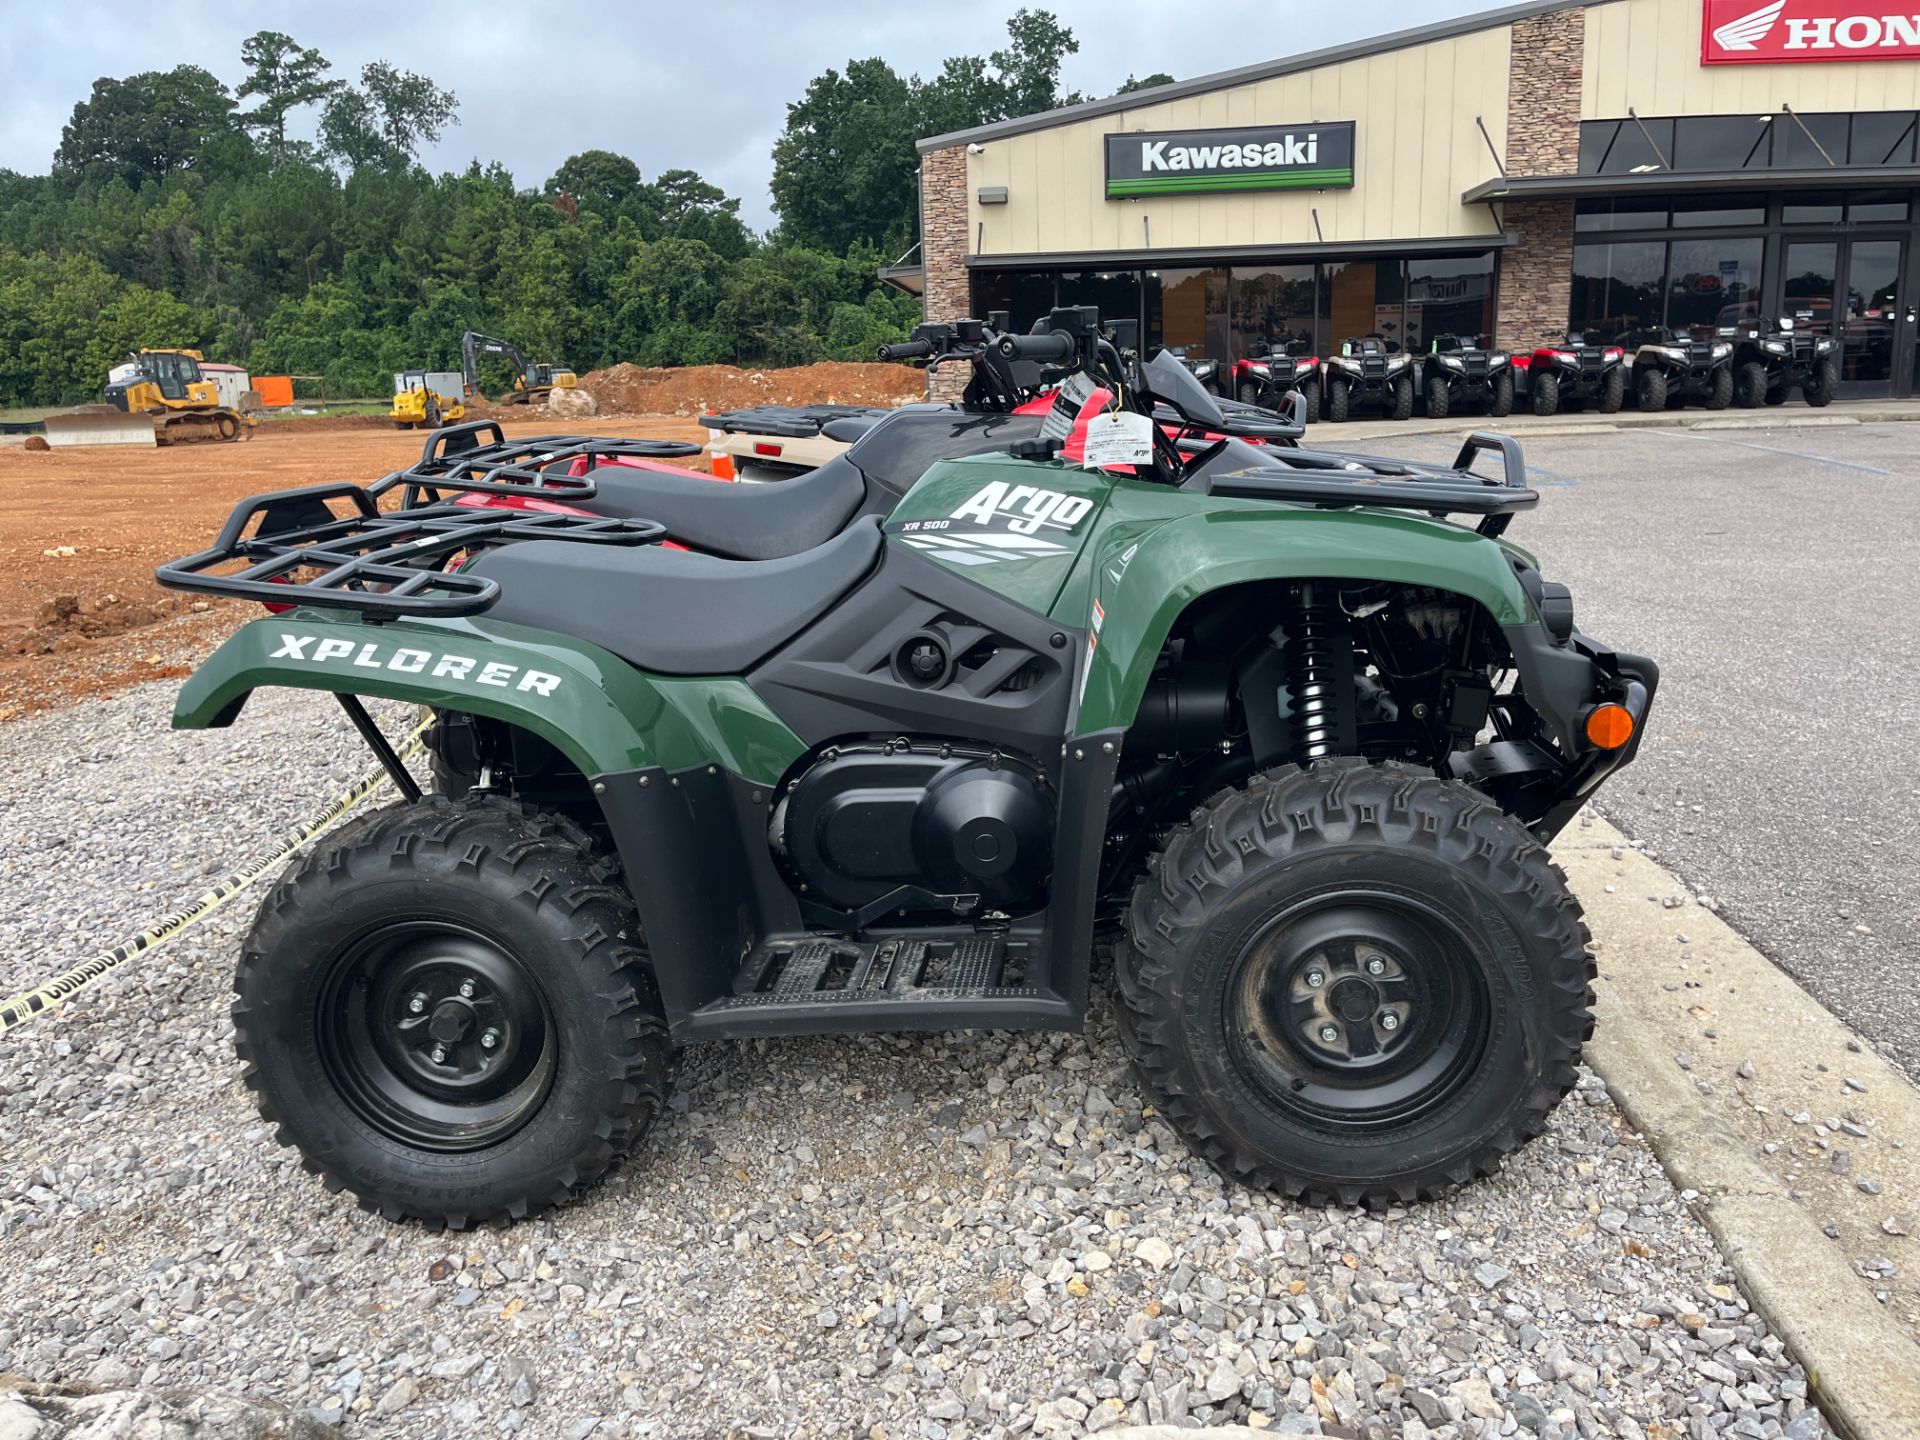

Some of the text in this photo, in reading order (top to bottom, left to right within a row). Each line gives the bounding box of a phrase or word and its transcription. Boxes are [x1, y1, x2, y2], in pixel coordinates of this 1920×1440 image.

[1142, 133, 1318, 171] Kawasaki
[902, 520, 950, 532] XR 500
[948, 480, 1094, 535] Argo
[269, 634, 562, 697] XPLORER
[1479, 910, 1537, 1005] KENDA
